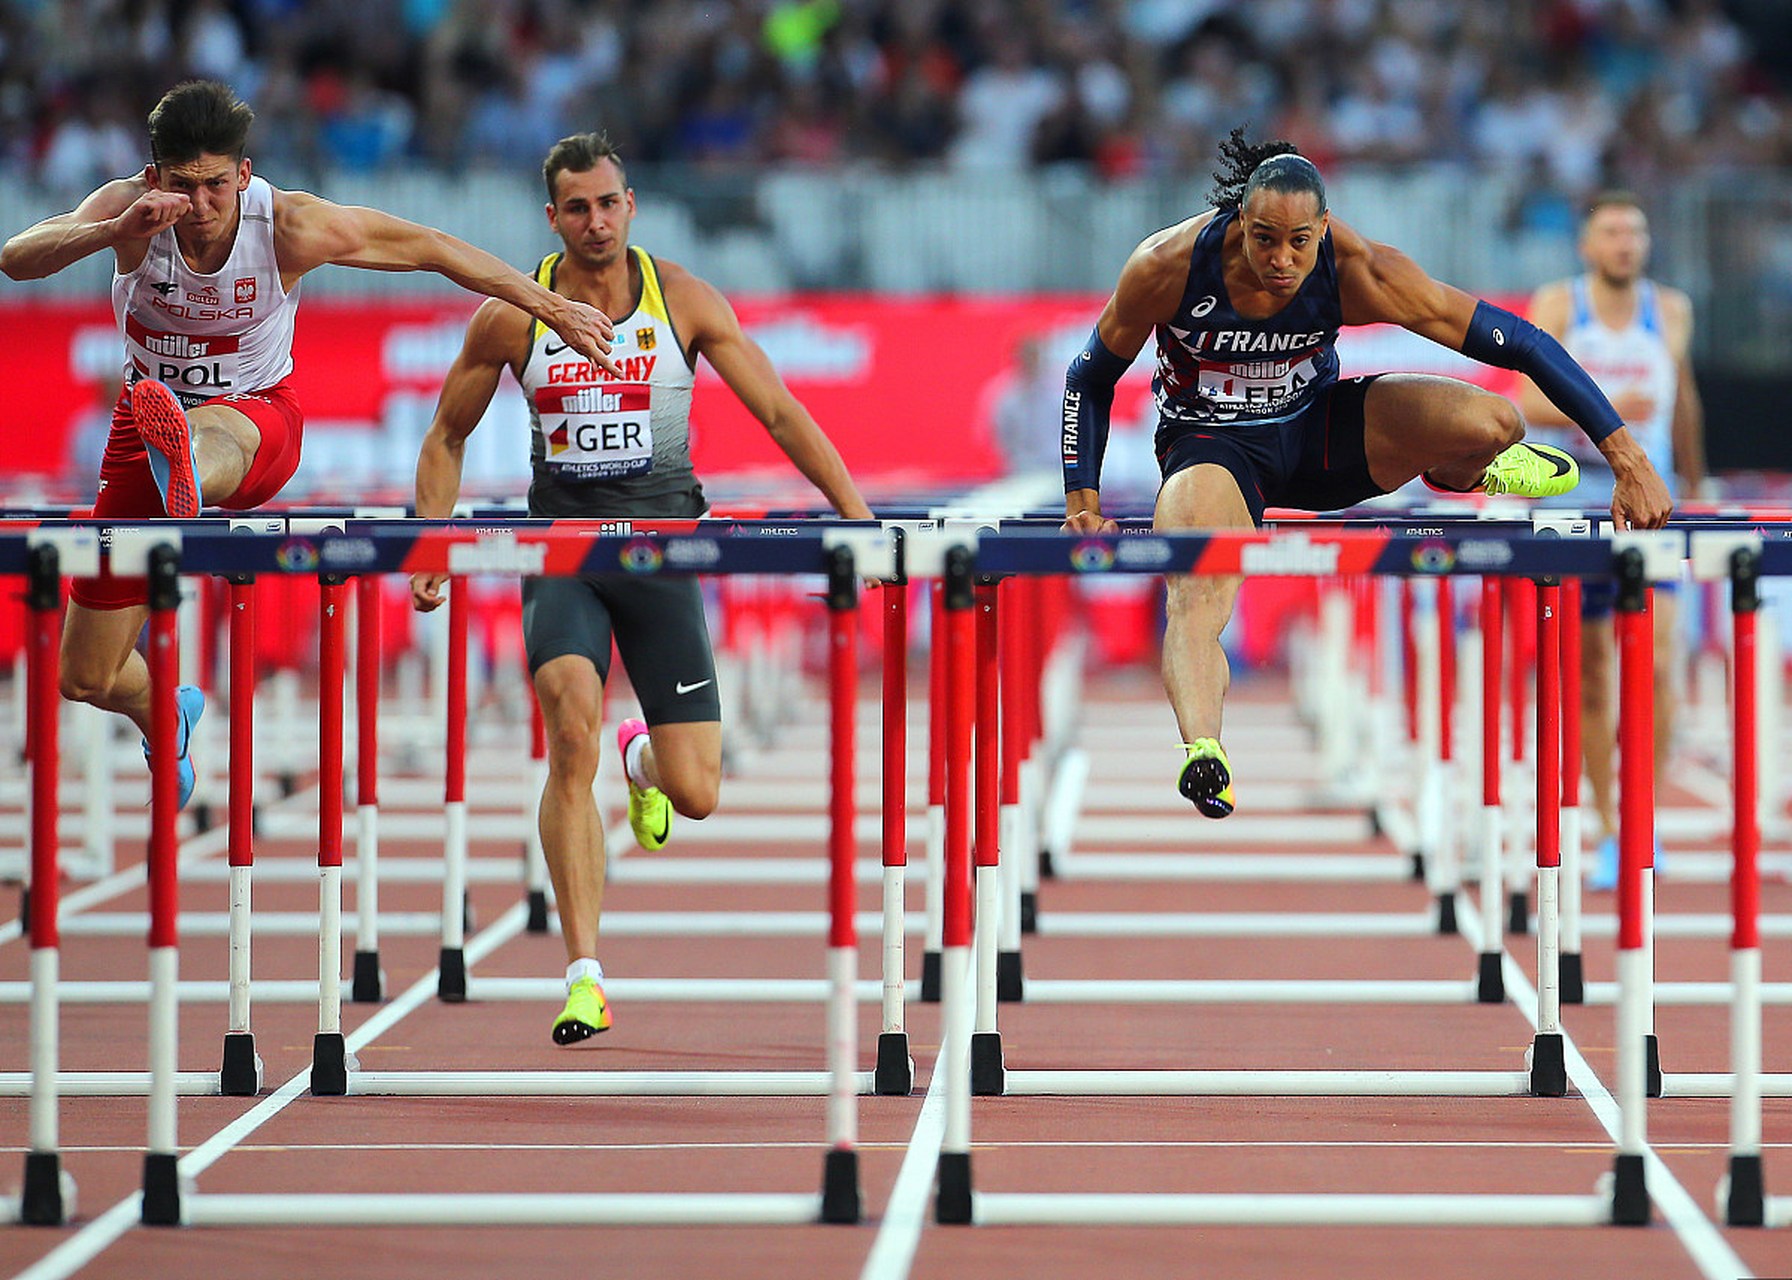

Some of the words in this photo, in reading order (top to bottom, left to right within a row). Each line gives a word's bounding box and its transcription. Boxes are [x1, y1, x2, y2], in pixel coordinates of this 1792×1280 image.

[153, 297, 253, 321] POLSKA
[145, 335, 210, 358] müller
[1214, 331, 1324, 352] FRANCE
[159, 363, 232, 387] POL
[561, 387, 623, 413] müller
[1063, 389, 1081, 455] FRANCE
[576, 422, 643, 451] GER
[760, 528, 798, 536] ATHLETICS
[1406, 528, 1444, 536] ATHLETICS
